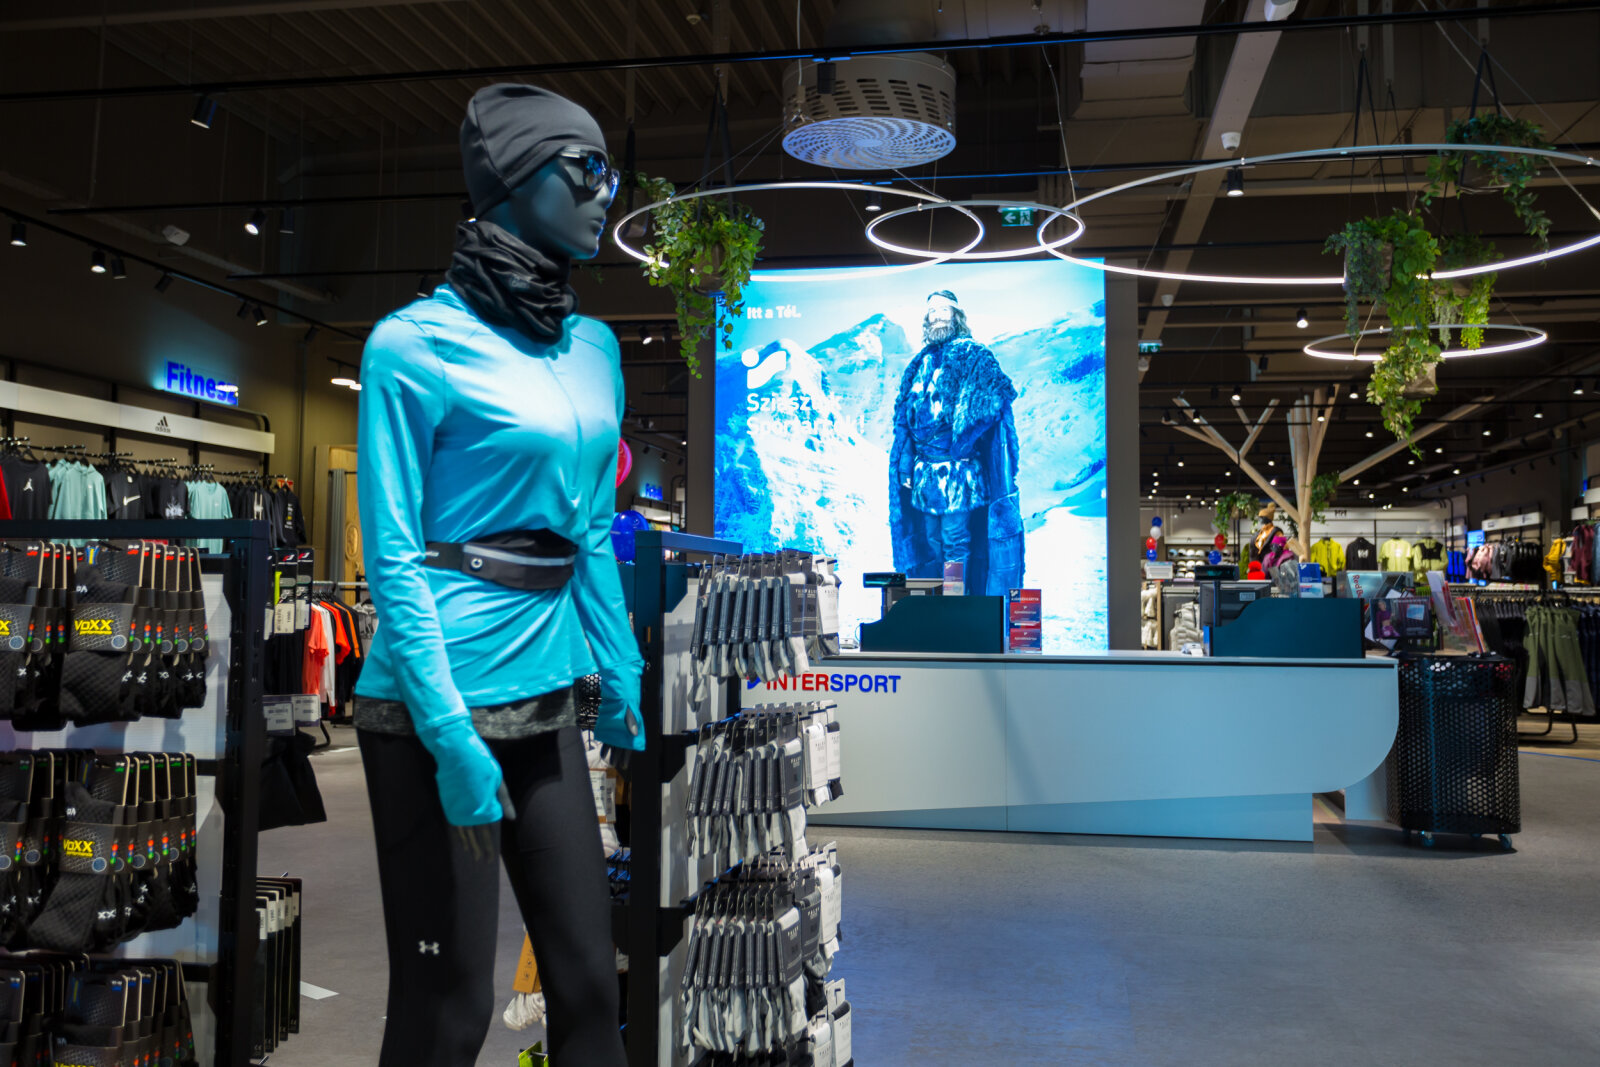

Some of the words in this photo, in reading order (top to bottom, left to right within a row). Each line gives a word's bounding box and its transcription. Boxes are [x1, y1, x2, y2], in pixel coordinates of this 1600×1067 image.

[747, 306, 763, 319] Itt
[765, 308, 773, 319] a
[767, 674, 901, 693] INTERSPORT
